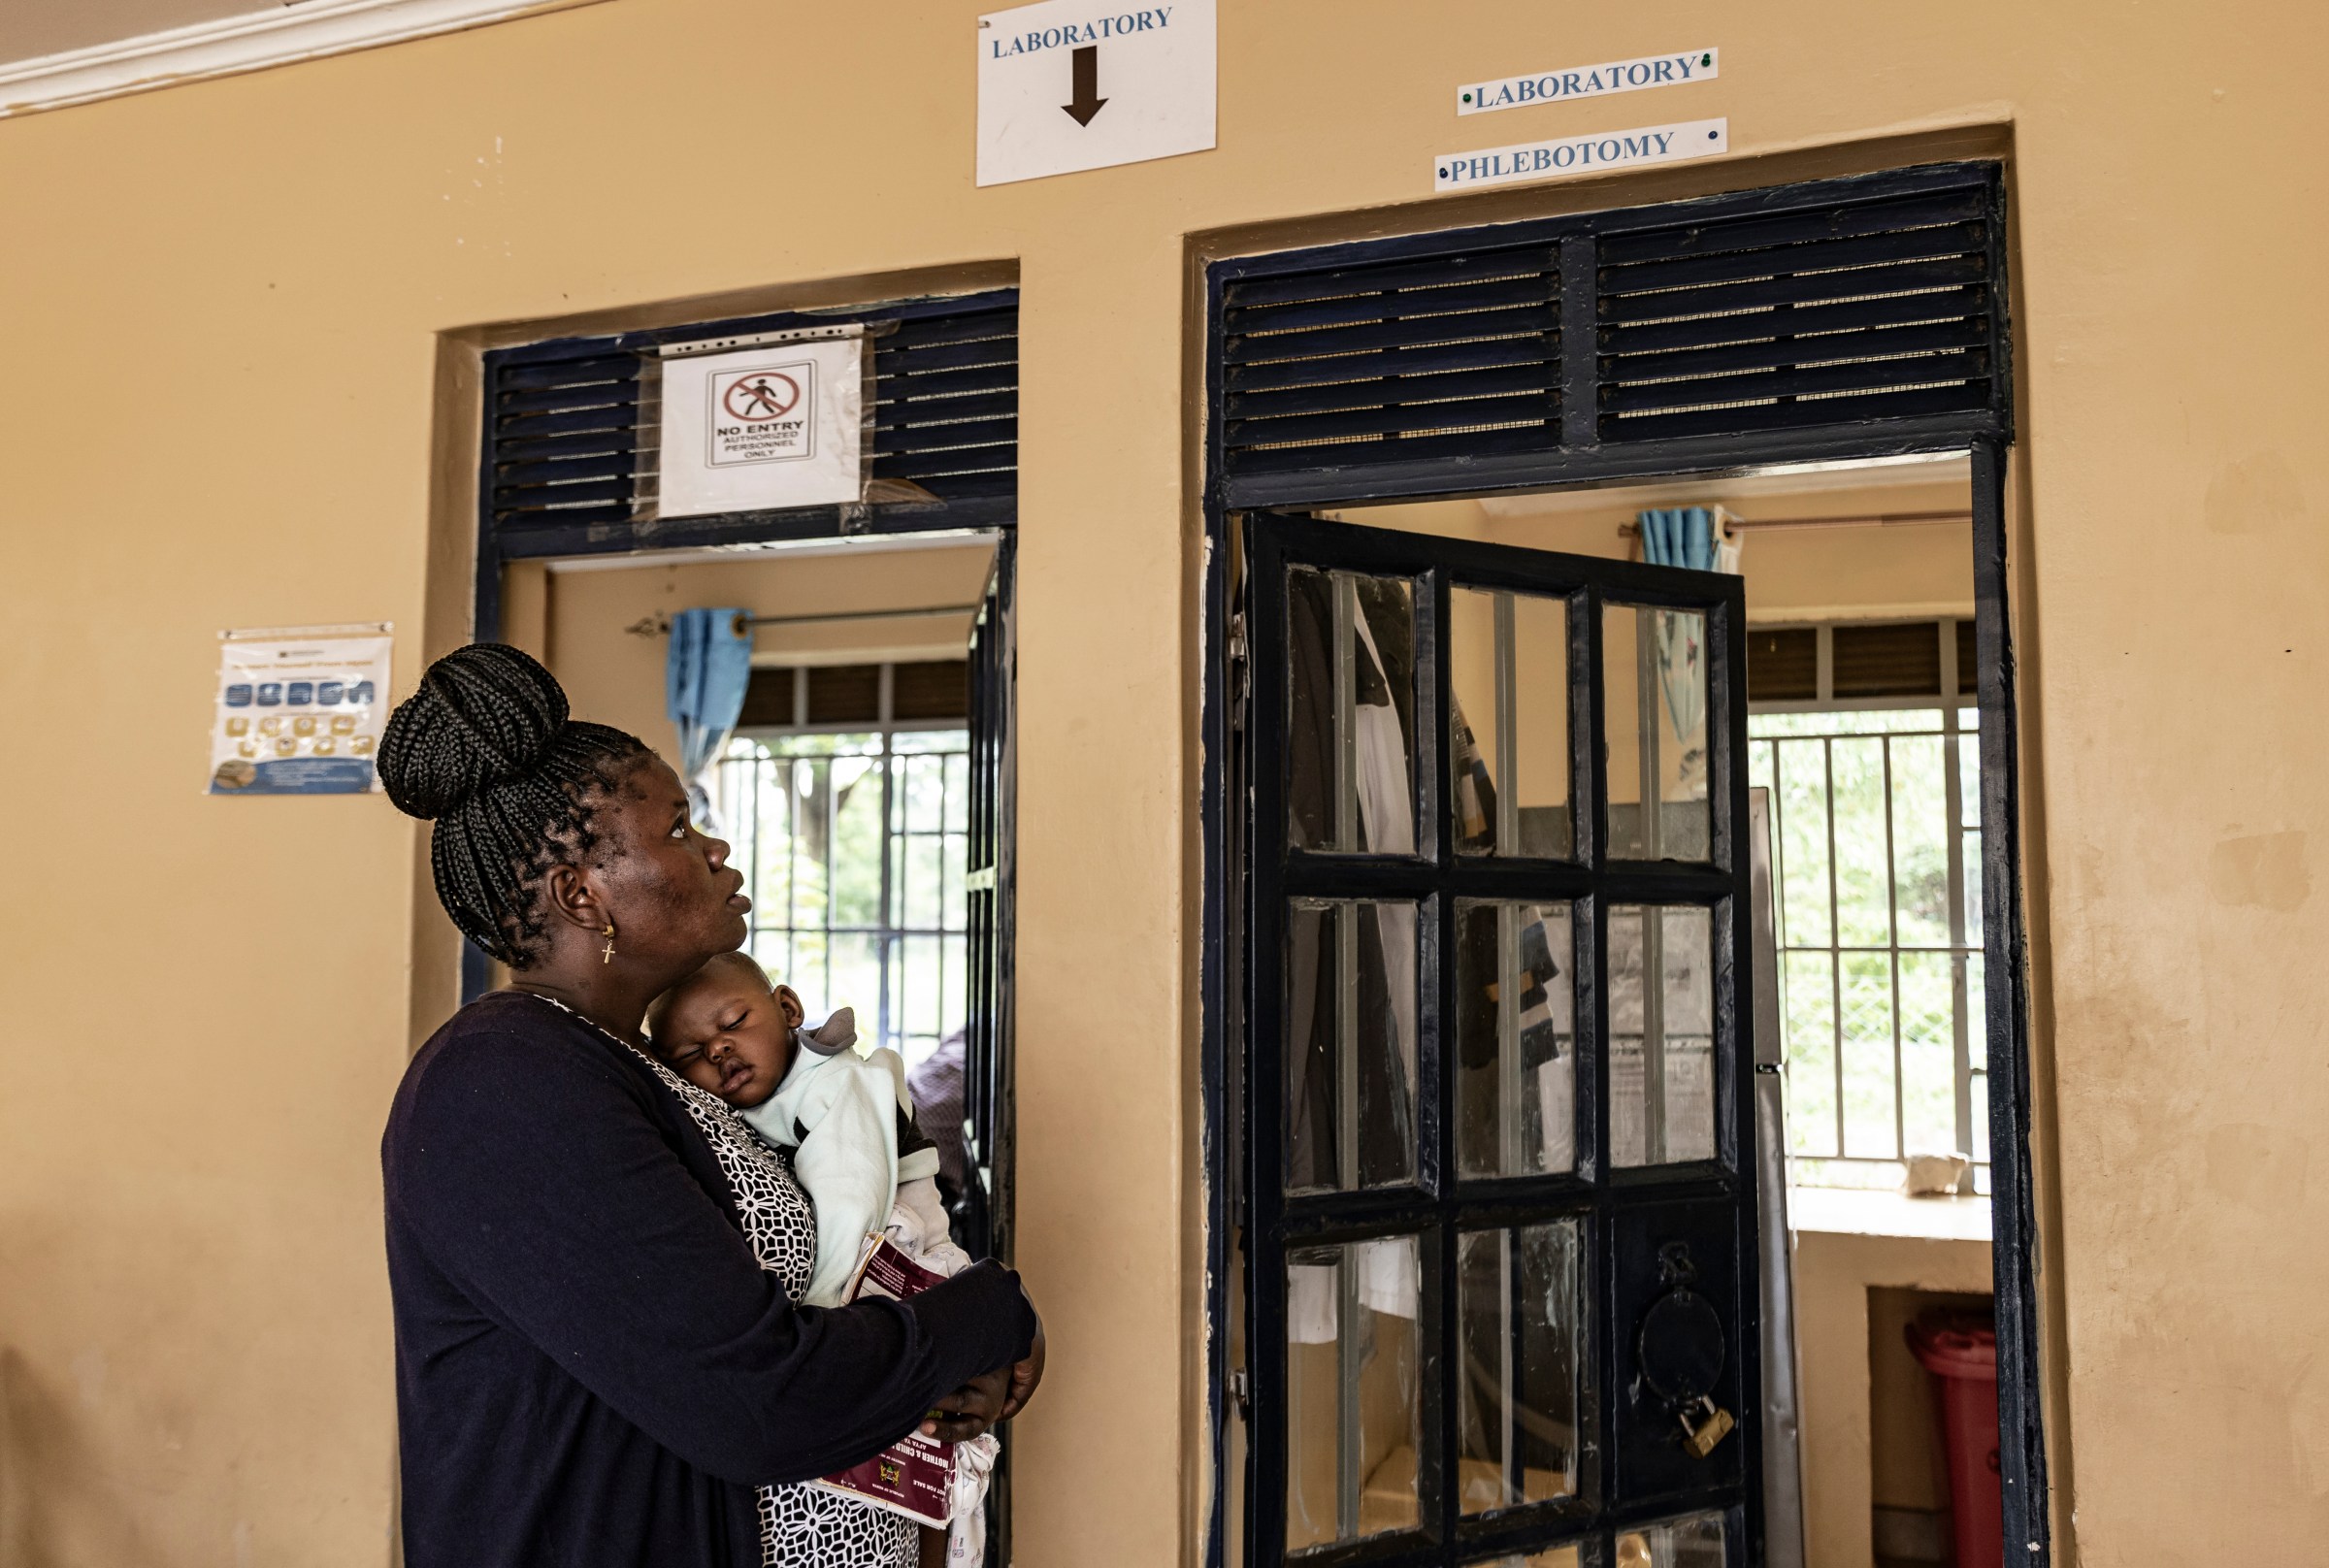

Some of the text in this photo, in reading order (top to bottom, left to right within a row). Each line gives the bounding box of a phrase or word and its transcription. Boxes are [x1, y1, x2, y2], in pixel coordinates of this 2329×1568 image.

[993, 7, 1172, 58] LABORATORY
[1475, 55, 1697, 109] LABORATORY
[1451, 132, 1674, 182] PHLEBOTOMY
[717, 420, 804, 437] NO ENTRY
[723, 431, 799, 443] AUTHORIZED
[725, 440, 797, 452] PERSONNEL
[896, 1442, 915, 1455] CHILD
[914, 1449, 922, 1457] &
[921, 1452, 949, 1468] MOTHER
[912, 1479, 926, 1487] SALE
[926, 1484, 936, 1492] FOR
